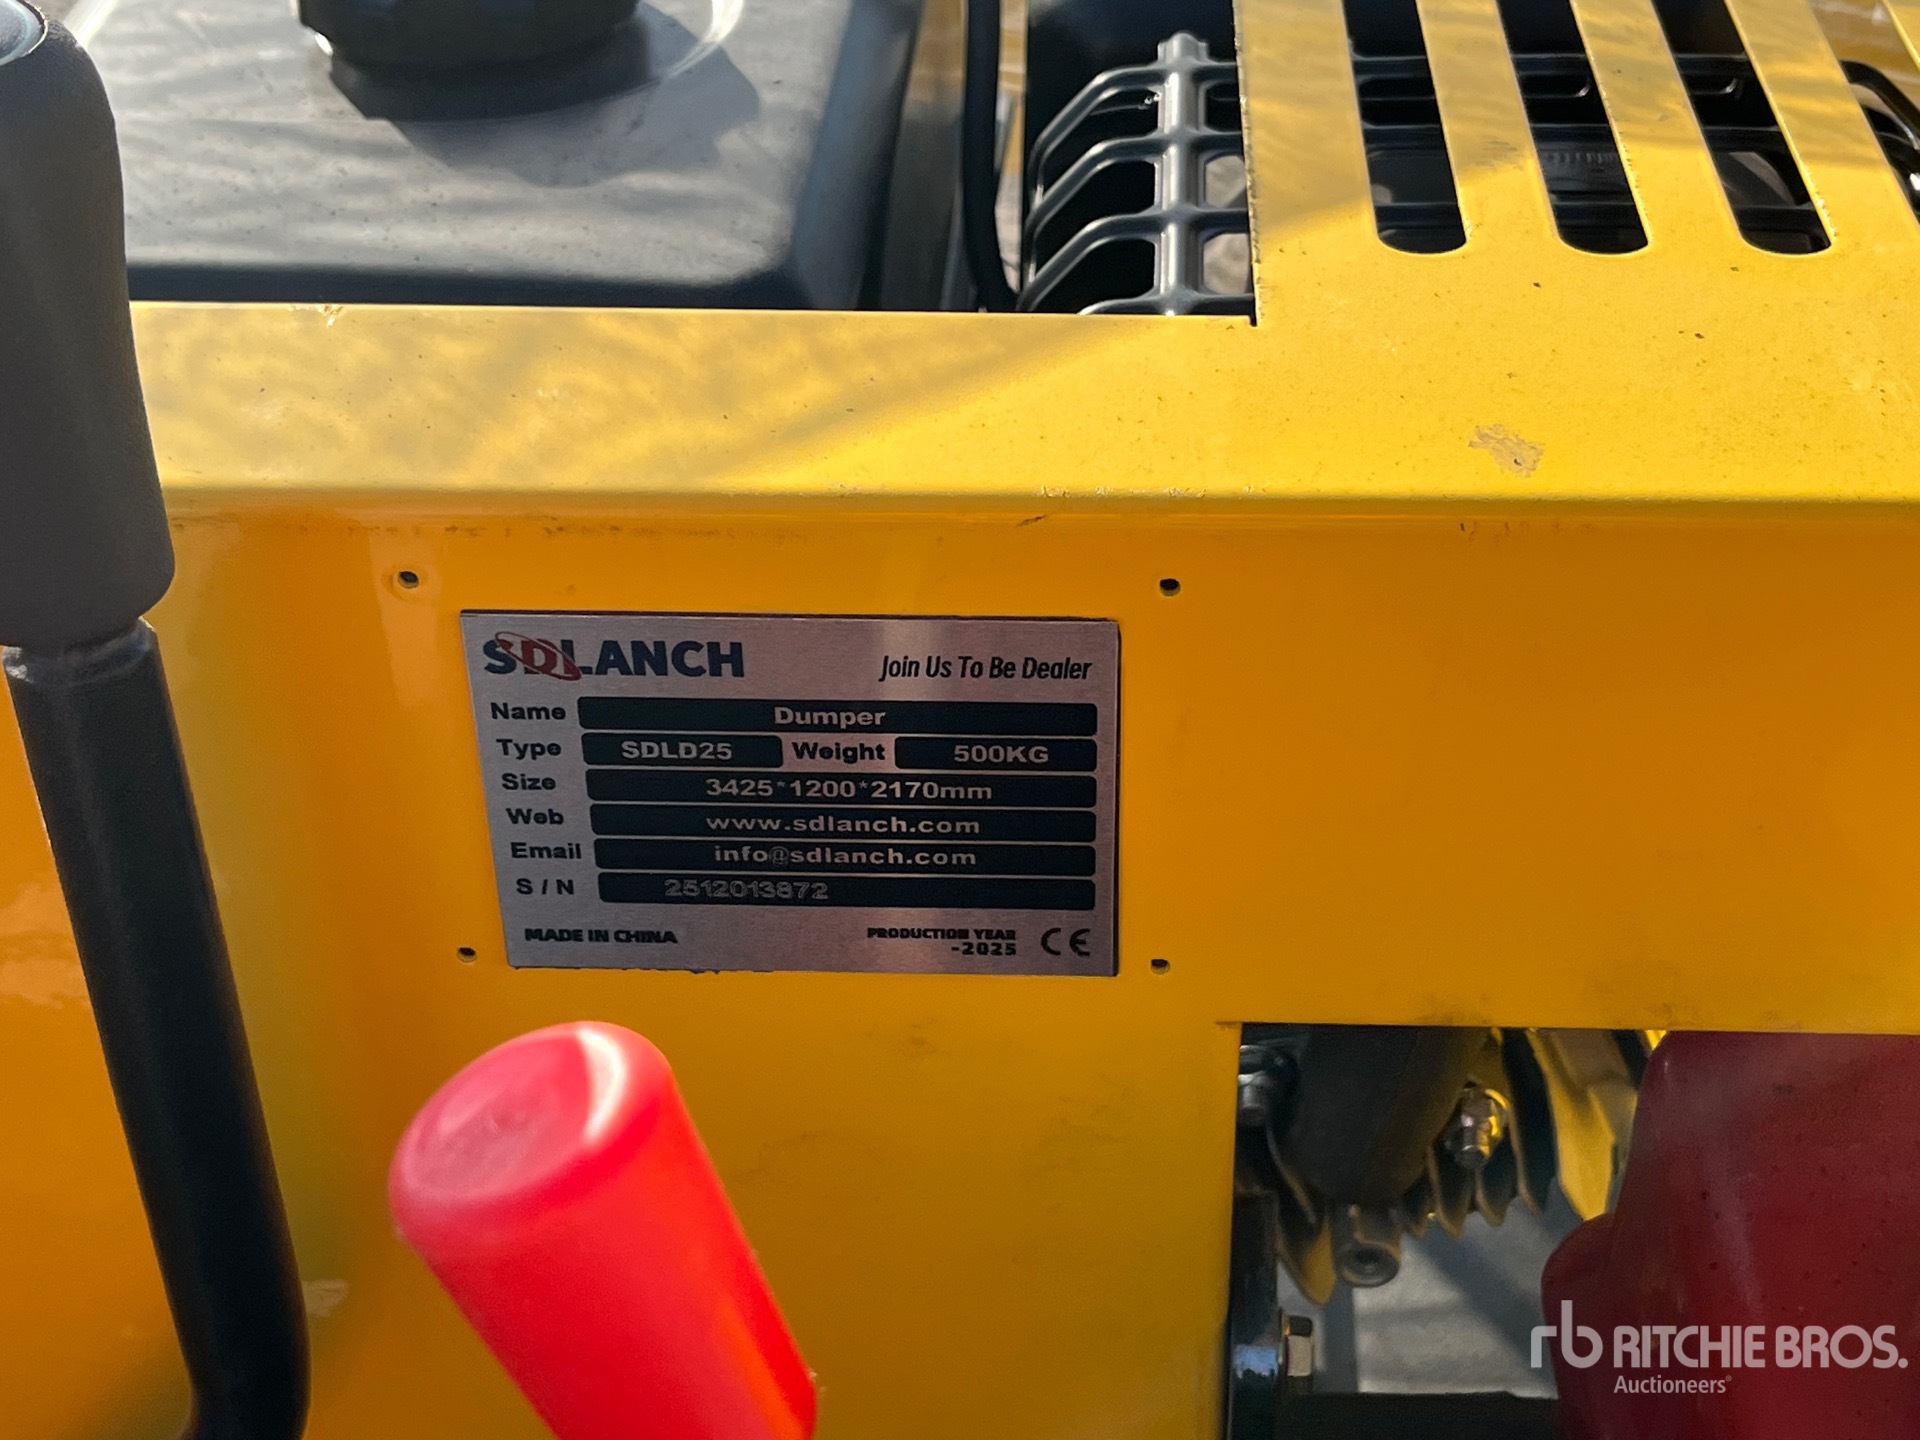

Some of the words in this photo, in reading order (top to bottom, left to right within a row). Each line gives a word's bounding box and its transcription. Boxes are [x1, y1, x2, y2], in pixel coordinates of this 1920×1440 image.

[483, 636, 745, 679] SDLANCH
[879, 656, 920, 682] Join
[926, 656, 952, 678] Us
[958, 656, 983, 678] To
[989, 656, 1016, 678] Be
[1021, 656, 1092, 680] Dealer
[491, 702, 567, 720] Name
[774, 706, 886, 729] Dumper
[496, 738, 562, 760] Type
[621, 740, 733, 760] SDLD25
[791, 741, 886, 764] Weight
[954, 745, 1049, 763] 500KG
[501, 773, 556, 791] Size
[506, 808, 565, 825] Web
[706, 815, 980, 834] www.sdlanch.com
[511, 842, 582, 859] Email
[714, 845, 977, 866] info@sdlanch.com
[664, 878, 829, 900] 2512013872
[525, 928, 584, 942] MADE
[588, 929, 609, 943] IN
[614, 930, 678, 944] CHINA
[867, 927, 969, 940] PRODUCTION
[973, 928, 1016, 940] YEAR
